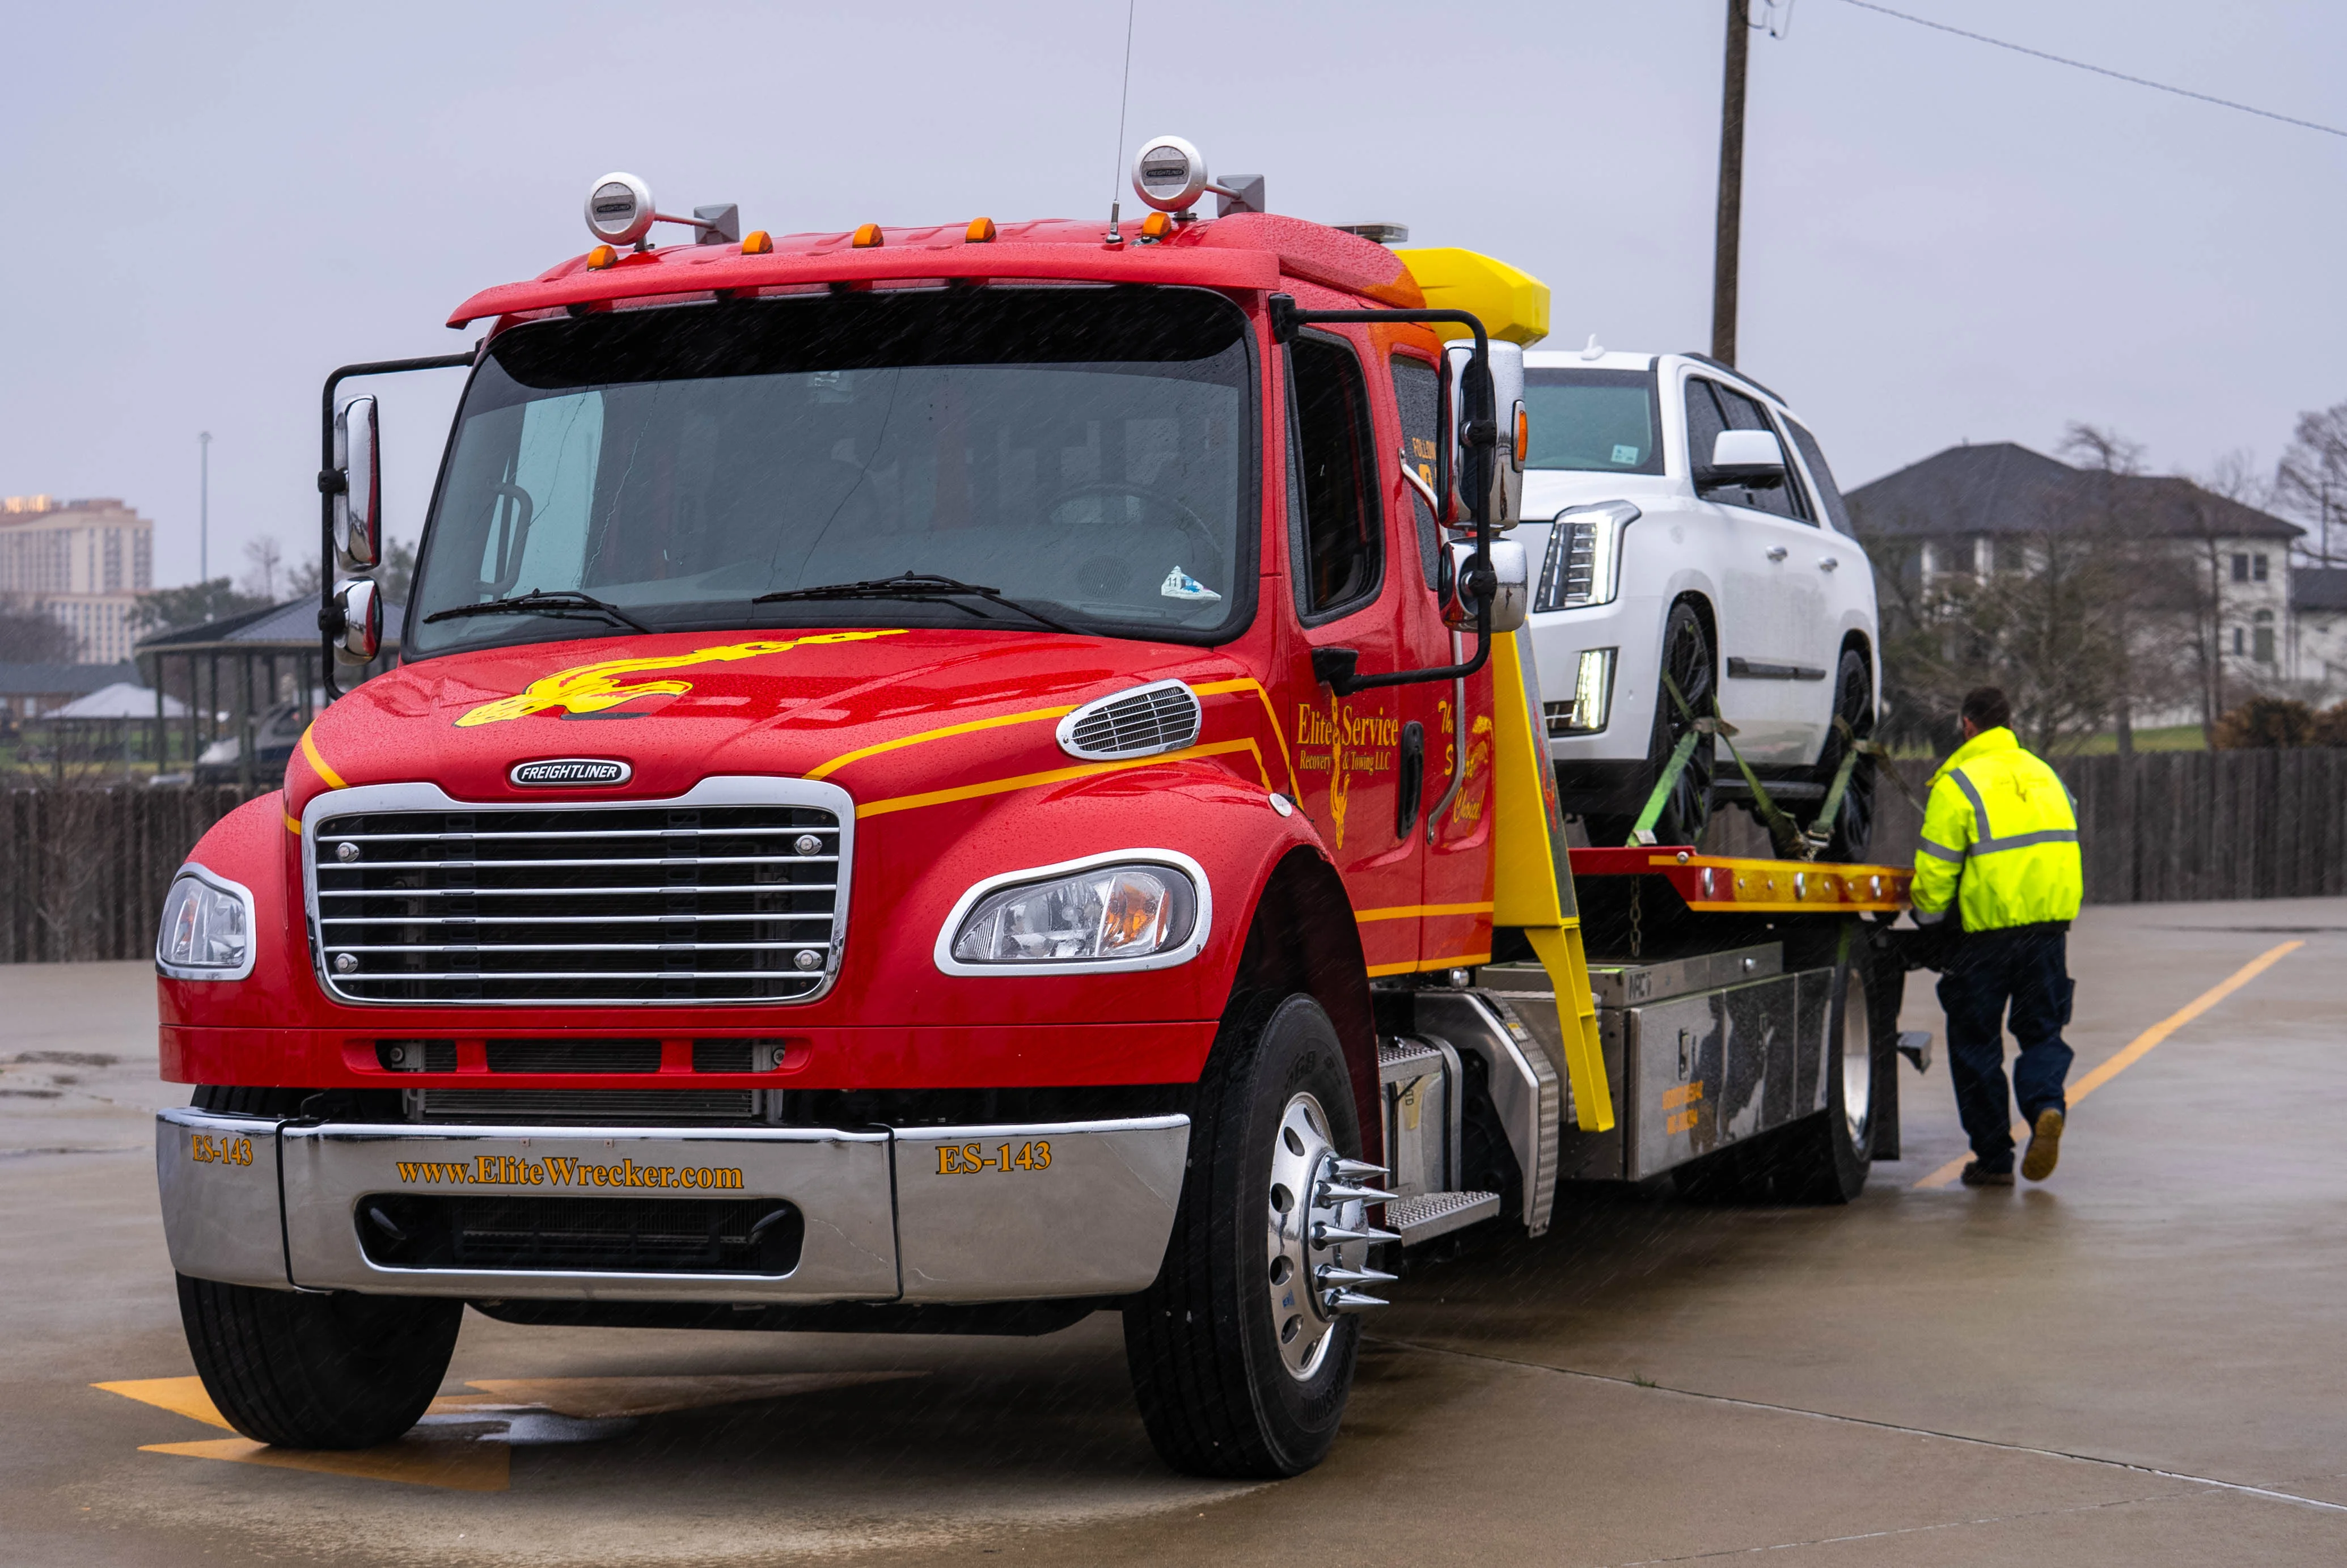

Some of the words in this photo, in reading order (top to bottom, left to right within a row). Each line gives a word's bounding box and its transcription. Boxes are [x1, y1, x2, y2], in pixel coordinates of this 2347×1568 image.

[1167, 576, 1177, 587] 11
[1296, 703, 1332, 746] Elite
[1342, 704, 1399, 747] Service
[521, 764, 618, 780] FREIGHTLINER
[1300, 750, 1332, 776] Recovery
[1342, 751, 1349, 771] &
[1351, 750, 1375, 776] Towing
[1375, 750, 1391, 771] LLC
[192, 1134, 253, 1167] ES-143
[935, 1140, 1052, 1175] ES-143
[396, 1155, 744, 1189] www.EliteWrecker.com
